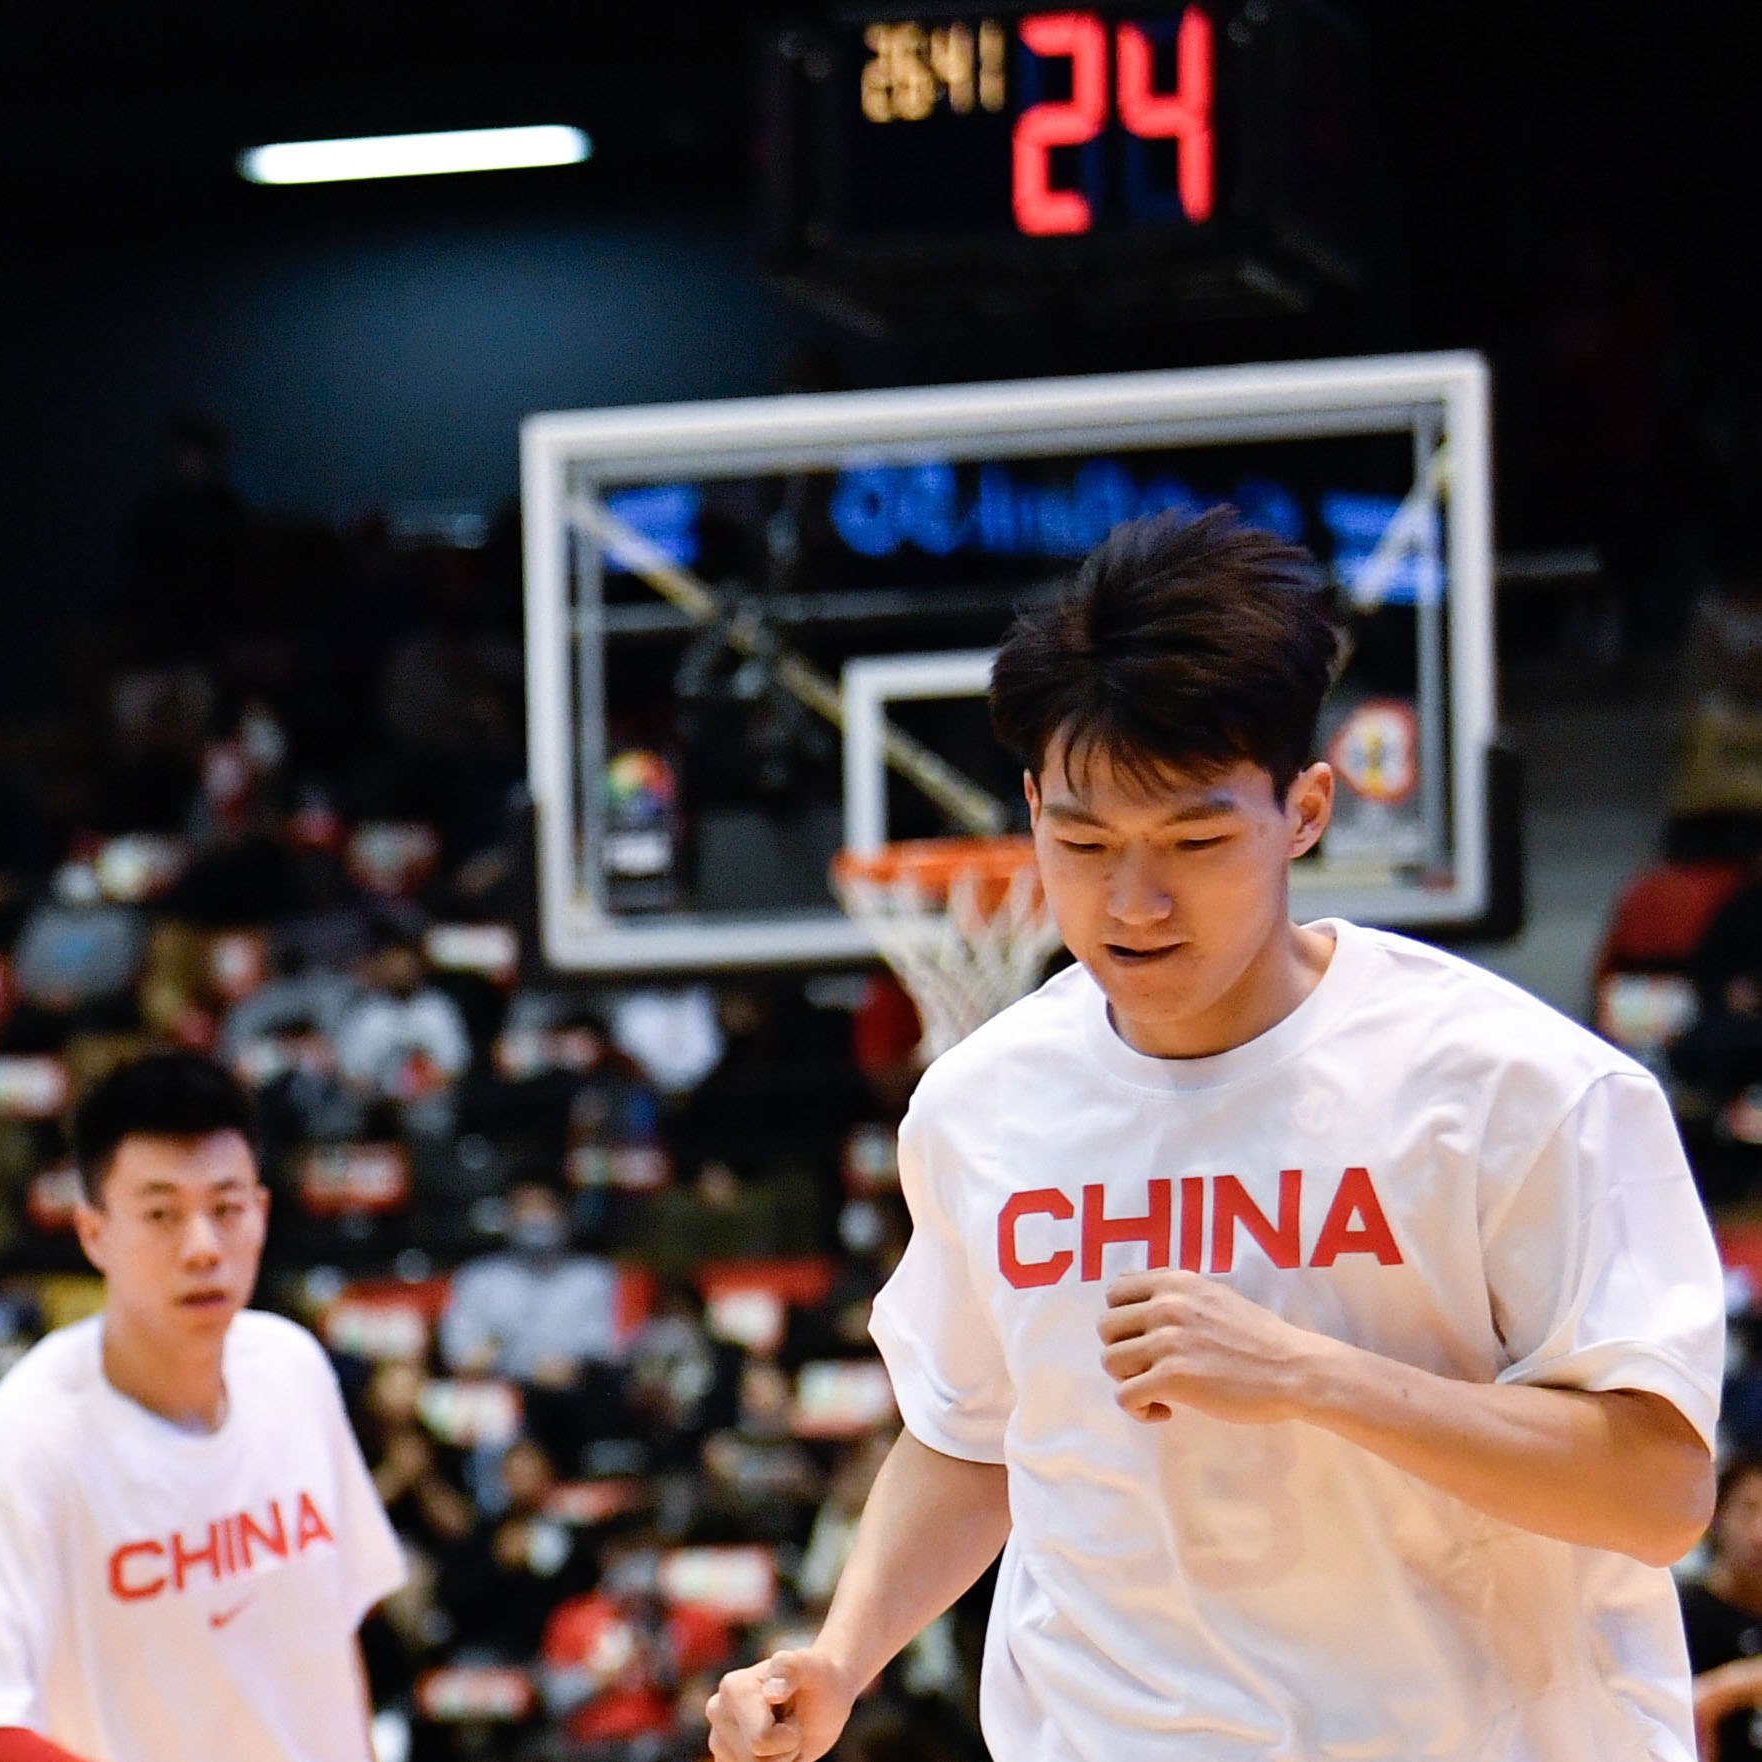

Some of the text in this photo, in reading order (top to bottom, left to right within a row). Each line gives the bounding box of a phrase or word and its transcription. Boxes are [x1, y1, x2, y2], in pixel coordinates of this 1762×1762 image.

[1011, 3, 1216, 237] 24
[997, 1166, 1404, 1290] CHINA
[108, 1490, 335, 1602] CHINA
